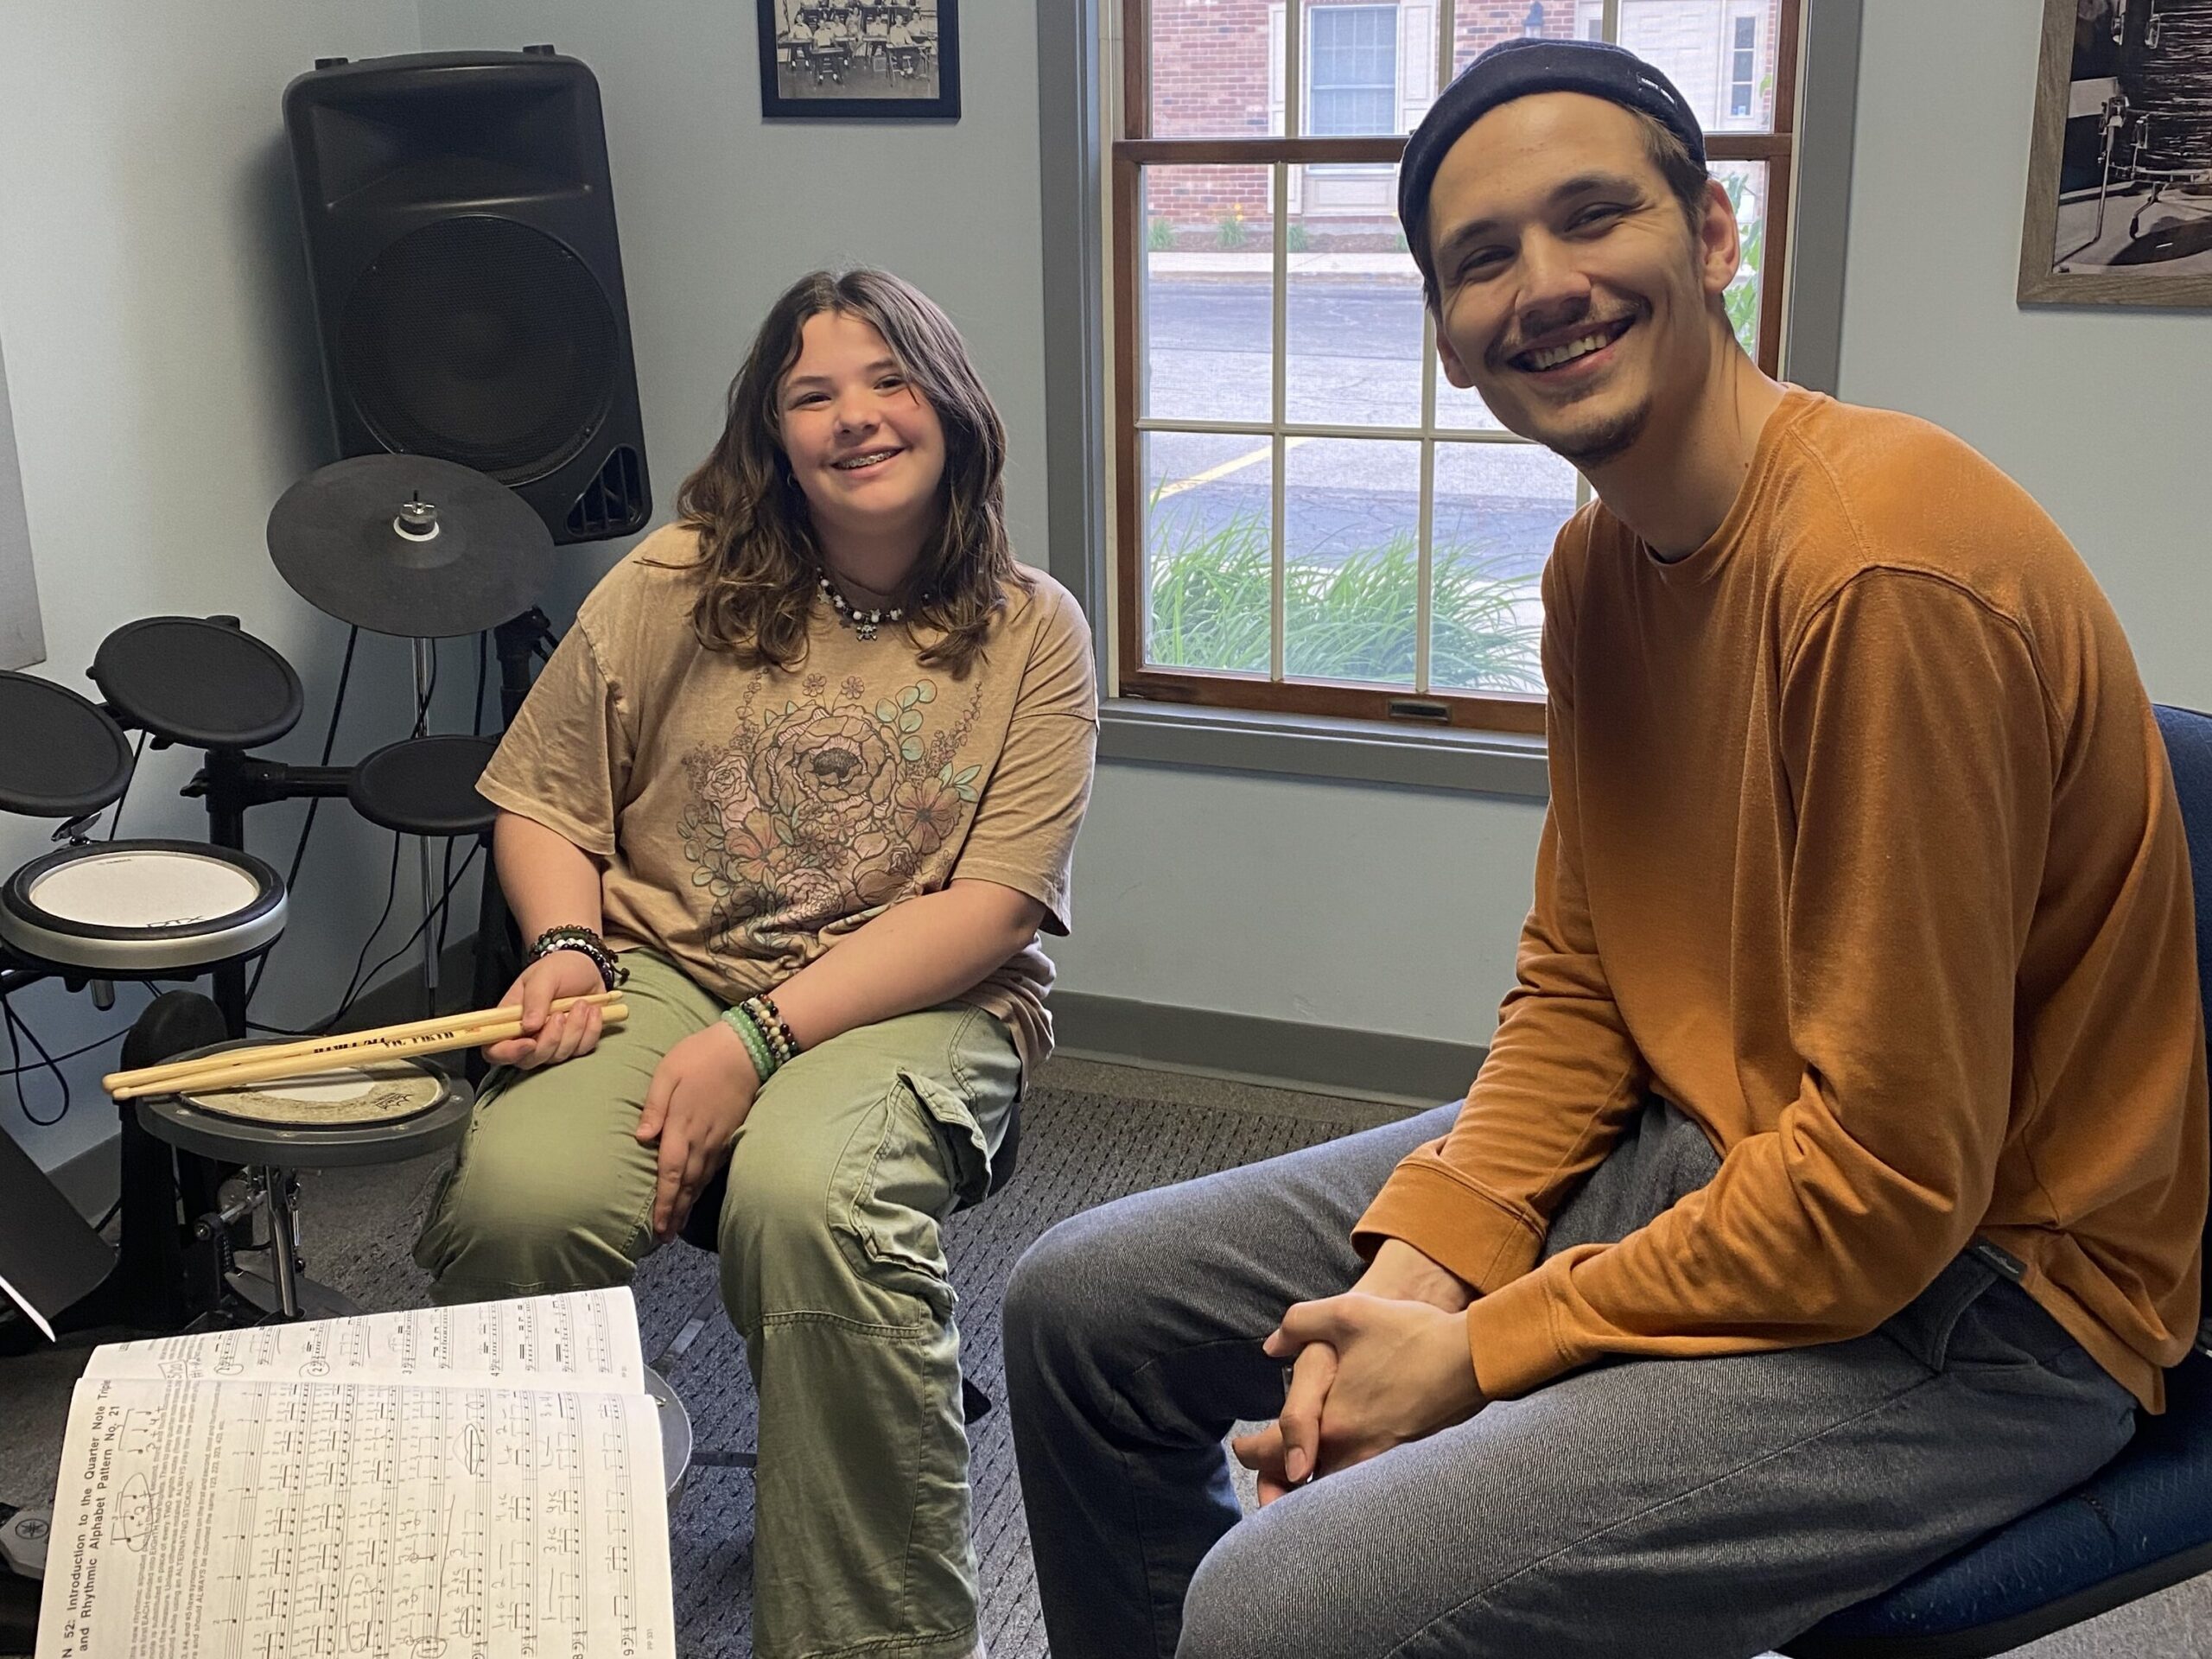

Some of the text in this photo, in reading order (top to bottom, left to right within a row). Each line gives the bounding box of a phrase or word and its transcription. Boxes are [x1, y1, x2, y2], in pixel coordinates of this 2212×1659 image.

[92, 1405, 105, 1429] Note
[84, 1437, 99, 1479] Quarter
[80, 1487, 92, 1505] the
[77, 1405, 118, 1651] and Rhythmic Alphabet Pattern No. 21
[78, 1514, 87, 1525] to
[66, 1534, 86, 1610] Introduction
[64, 1618, 75, 1637] 52:
